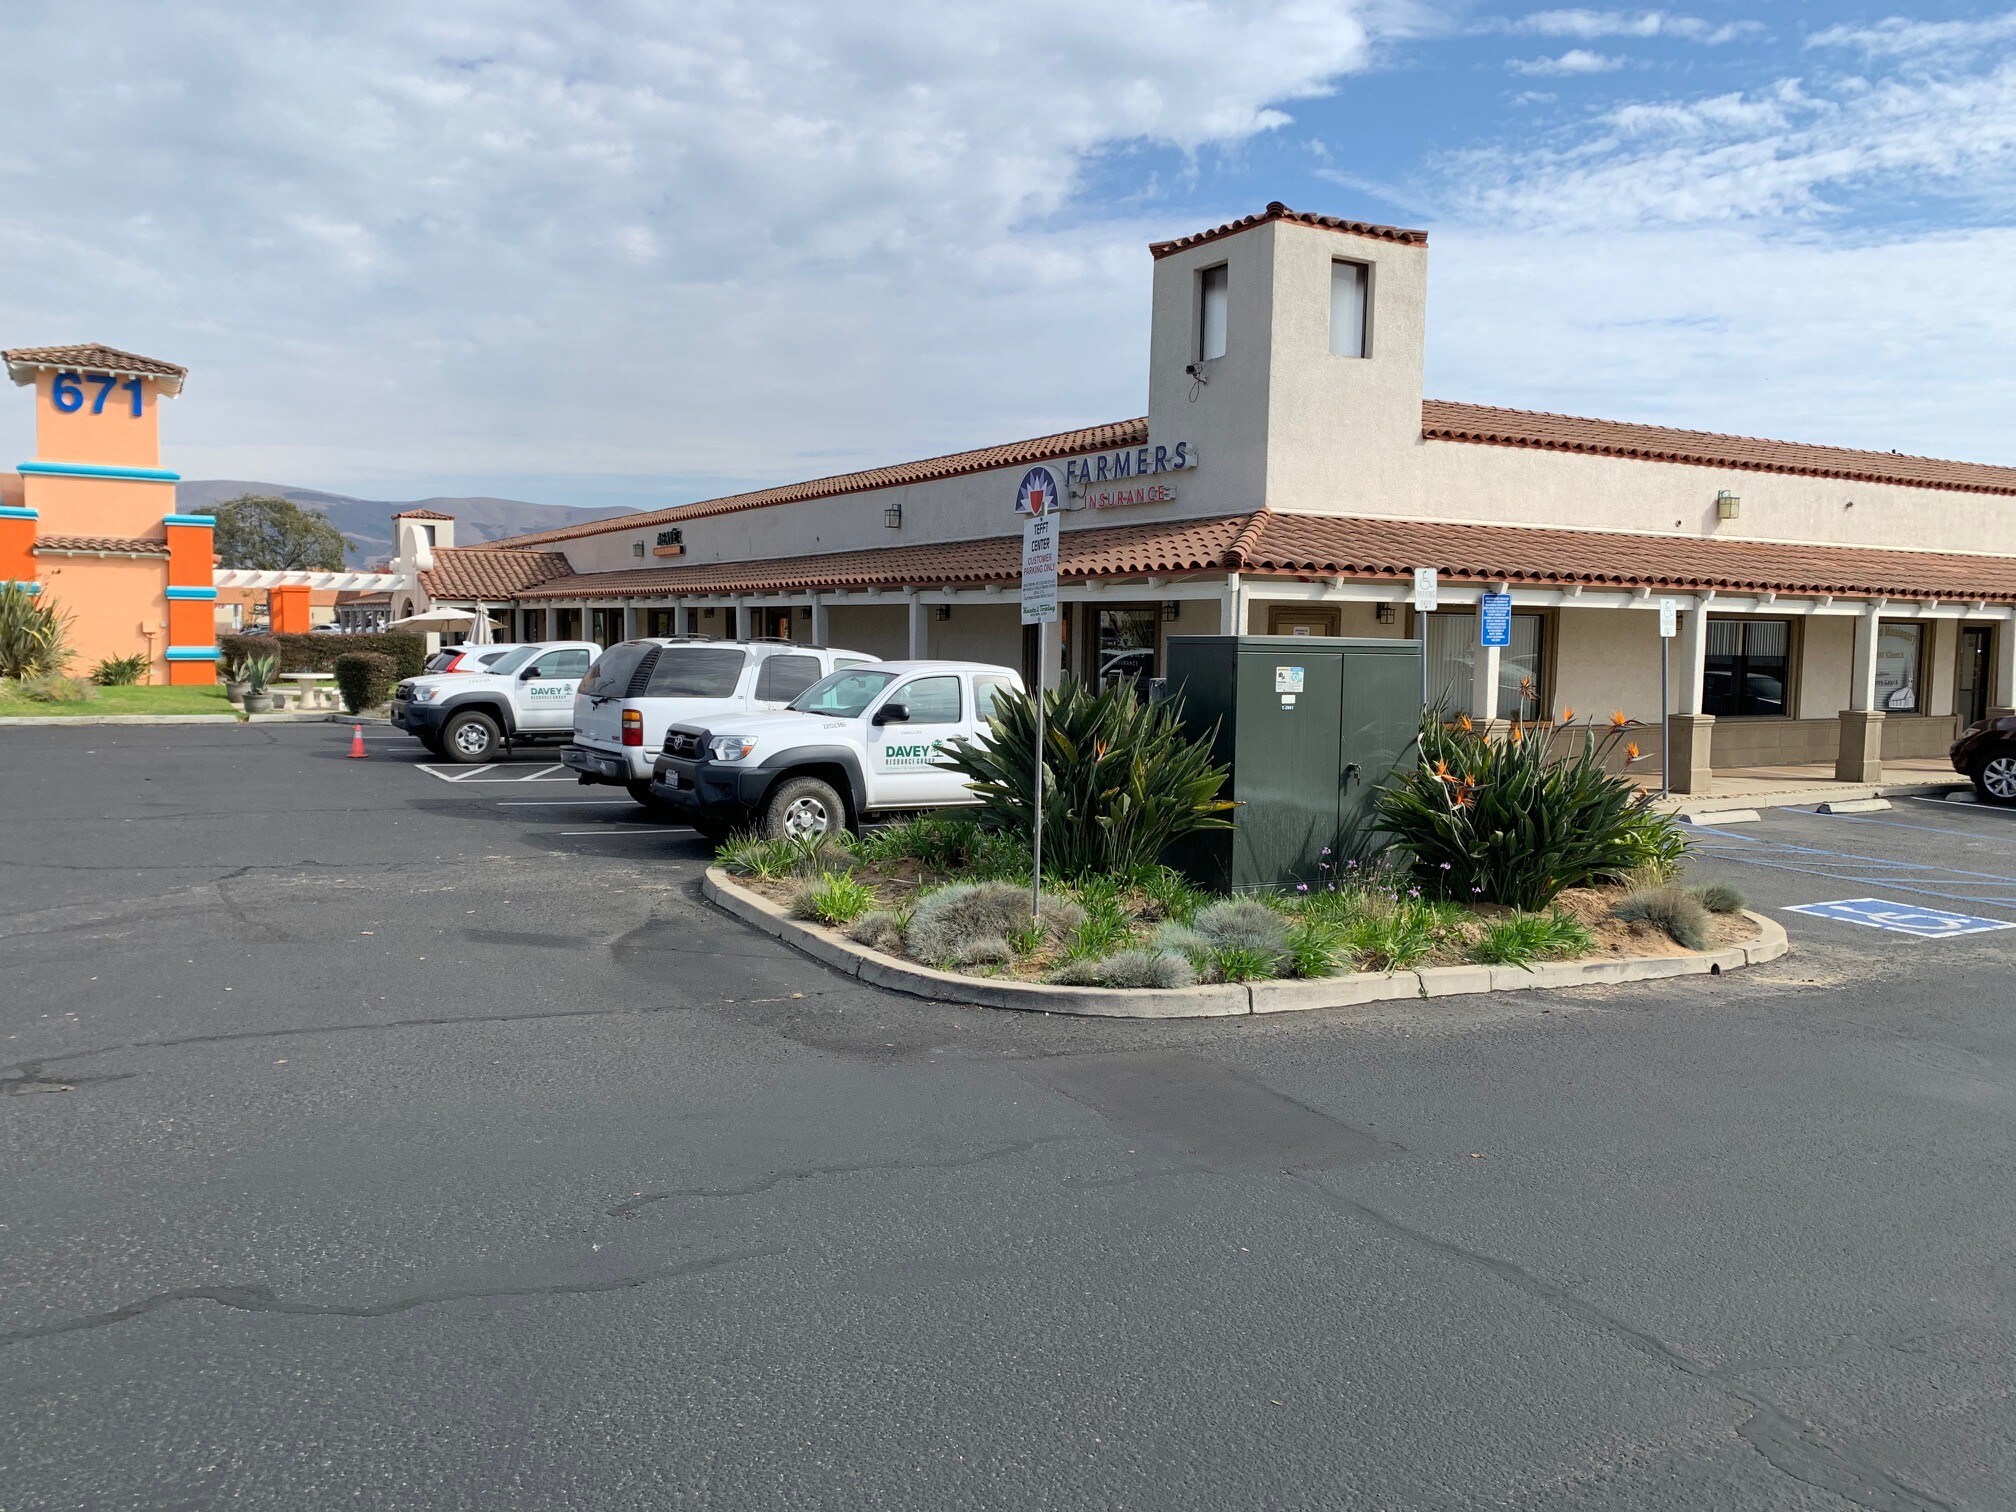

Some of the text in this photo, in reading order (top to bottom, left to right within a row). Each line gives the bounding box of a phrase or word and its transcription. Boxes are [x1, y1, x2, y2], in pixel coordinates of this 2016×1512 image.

[53, 372, 142, 417] 671
[1066, 441, 1187, 485] FARMERS
[1084, 485, 1166, 510] INSURANCE
[1034, 521, 1049, 535] TEFFT
[1031, 537, 1050, 552] CENTER
[1027, 553, 1052, 566] CUSTOMER
[1024, 562, 1055, 576] PARKING ONLY
[530, 687, 562, 695] DAVEY
[885, 745, 930, 758] DAVEY
[886, 757, 935, 766] RESOURCE GROUP
